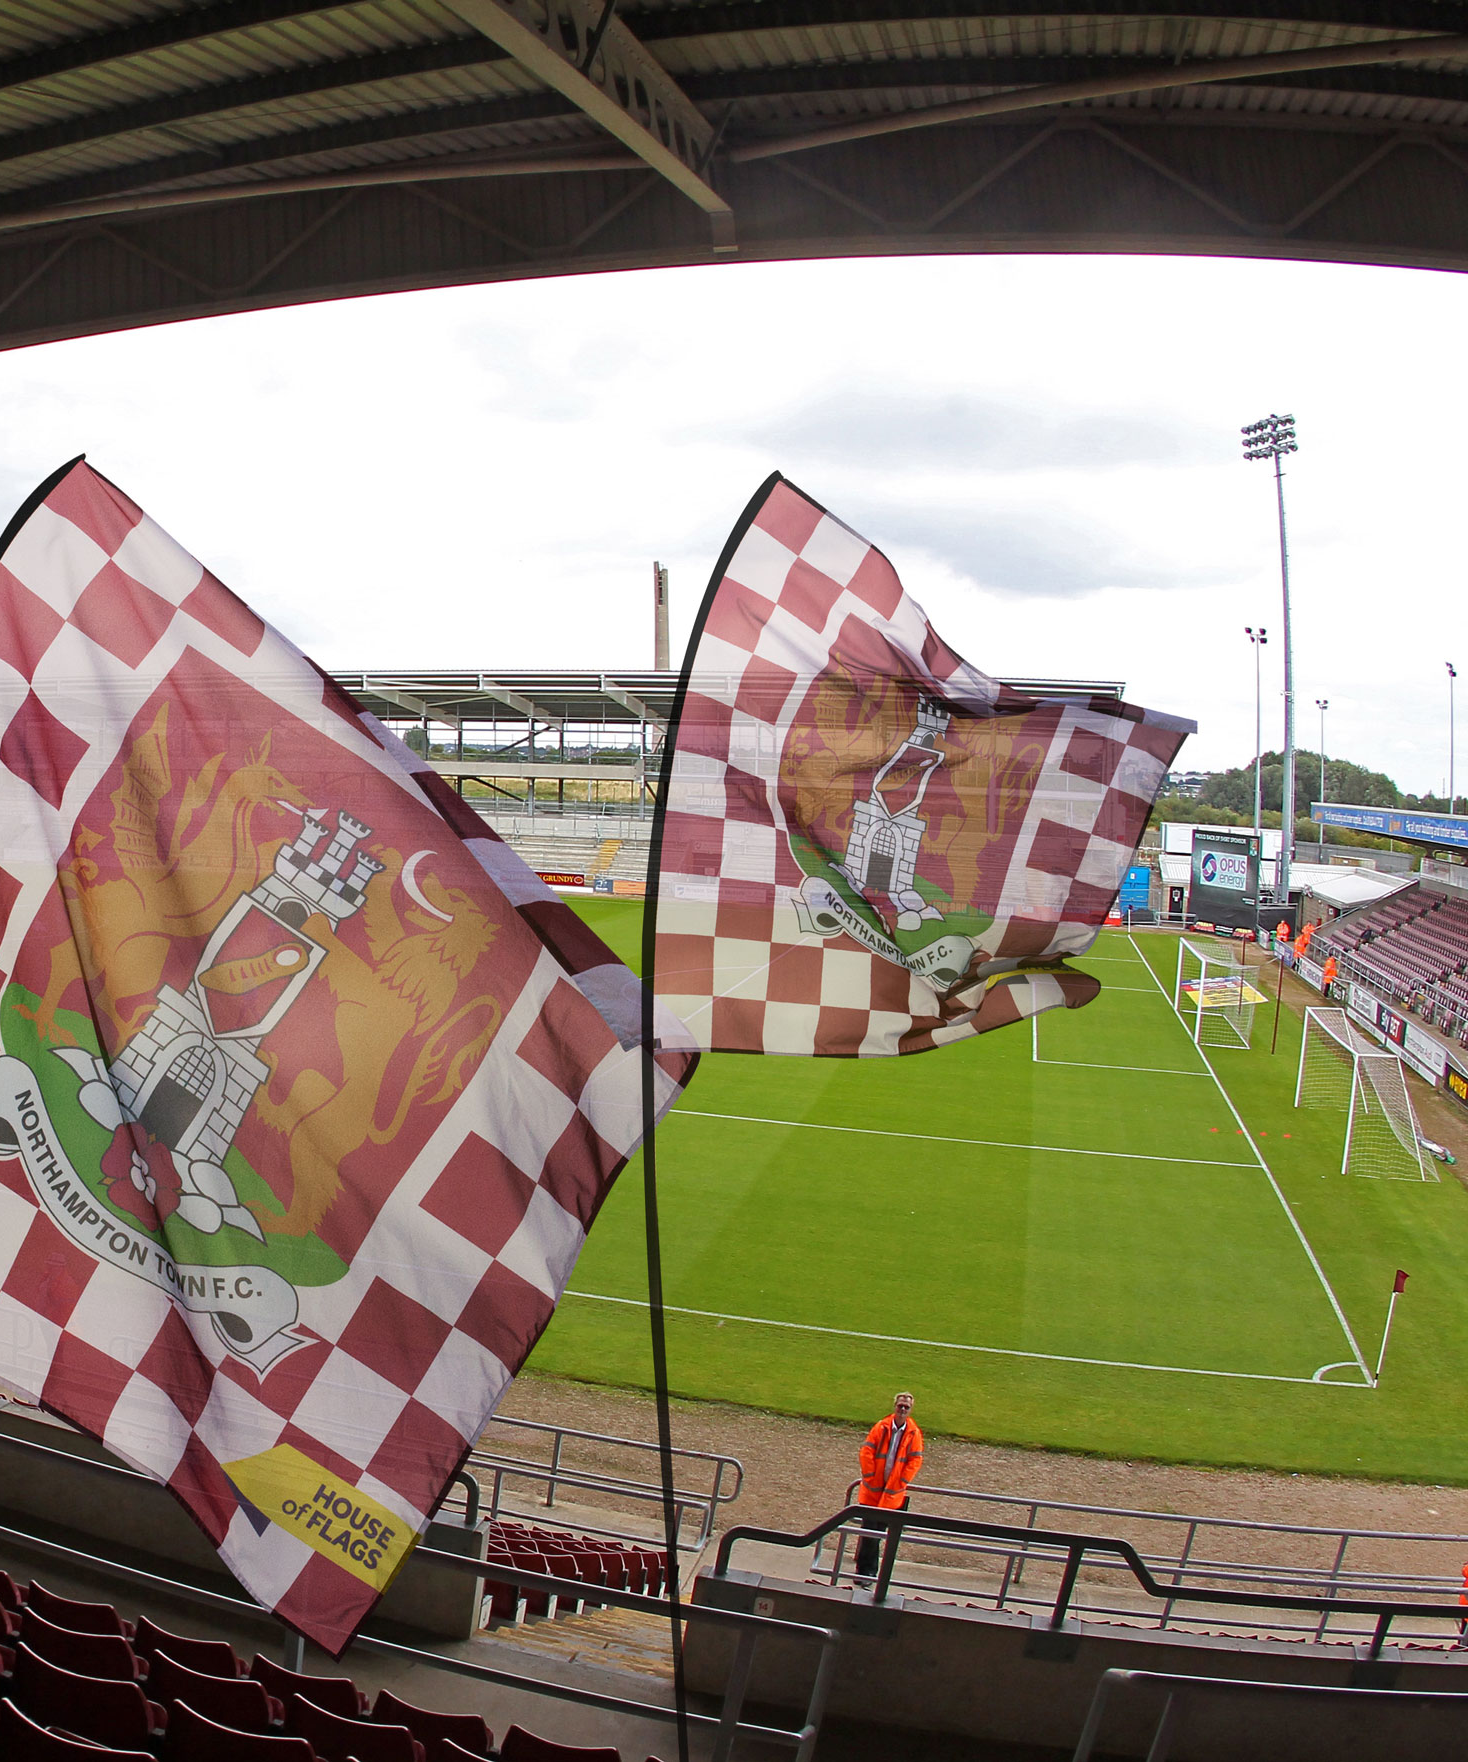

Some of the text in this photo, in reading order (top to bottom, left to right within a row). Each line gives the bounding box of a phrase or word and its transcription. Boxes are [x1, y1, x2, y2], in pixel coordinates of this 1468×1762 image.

[543, 874, 574, 885] GRUNDY
[1220, 858, 1246, 874] OPUS
[1220, 873, 1245, 888] energy
[824, 891, 907, 966] NORTHAMPTO
[927, 945, 953, 965] F.C.
[14, 1089, 149, 1266] NORTHAMPTON
[213, 1276, 263, 1299] F.C.
[282, 1499, 383, 1570] of FLAGS
[313, 1484, 396, 1551] HOUSE
